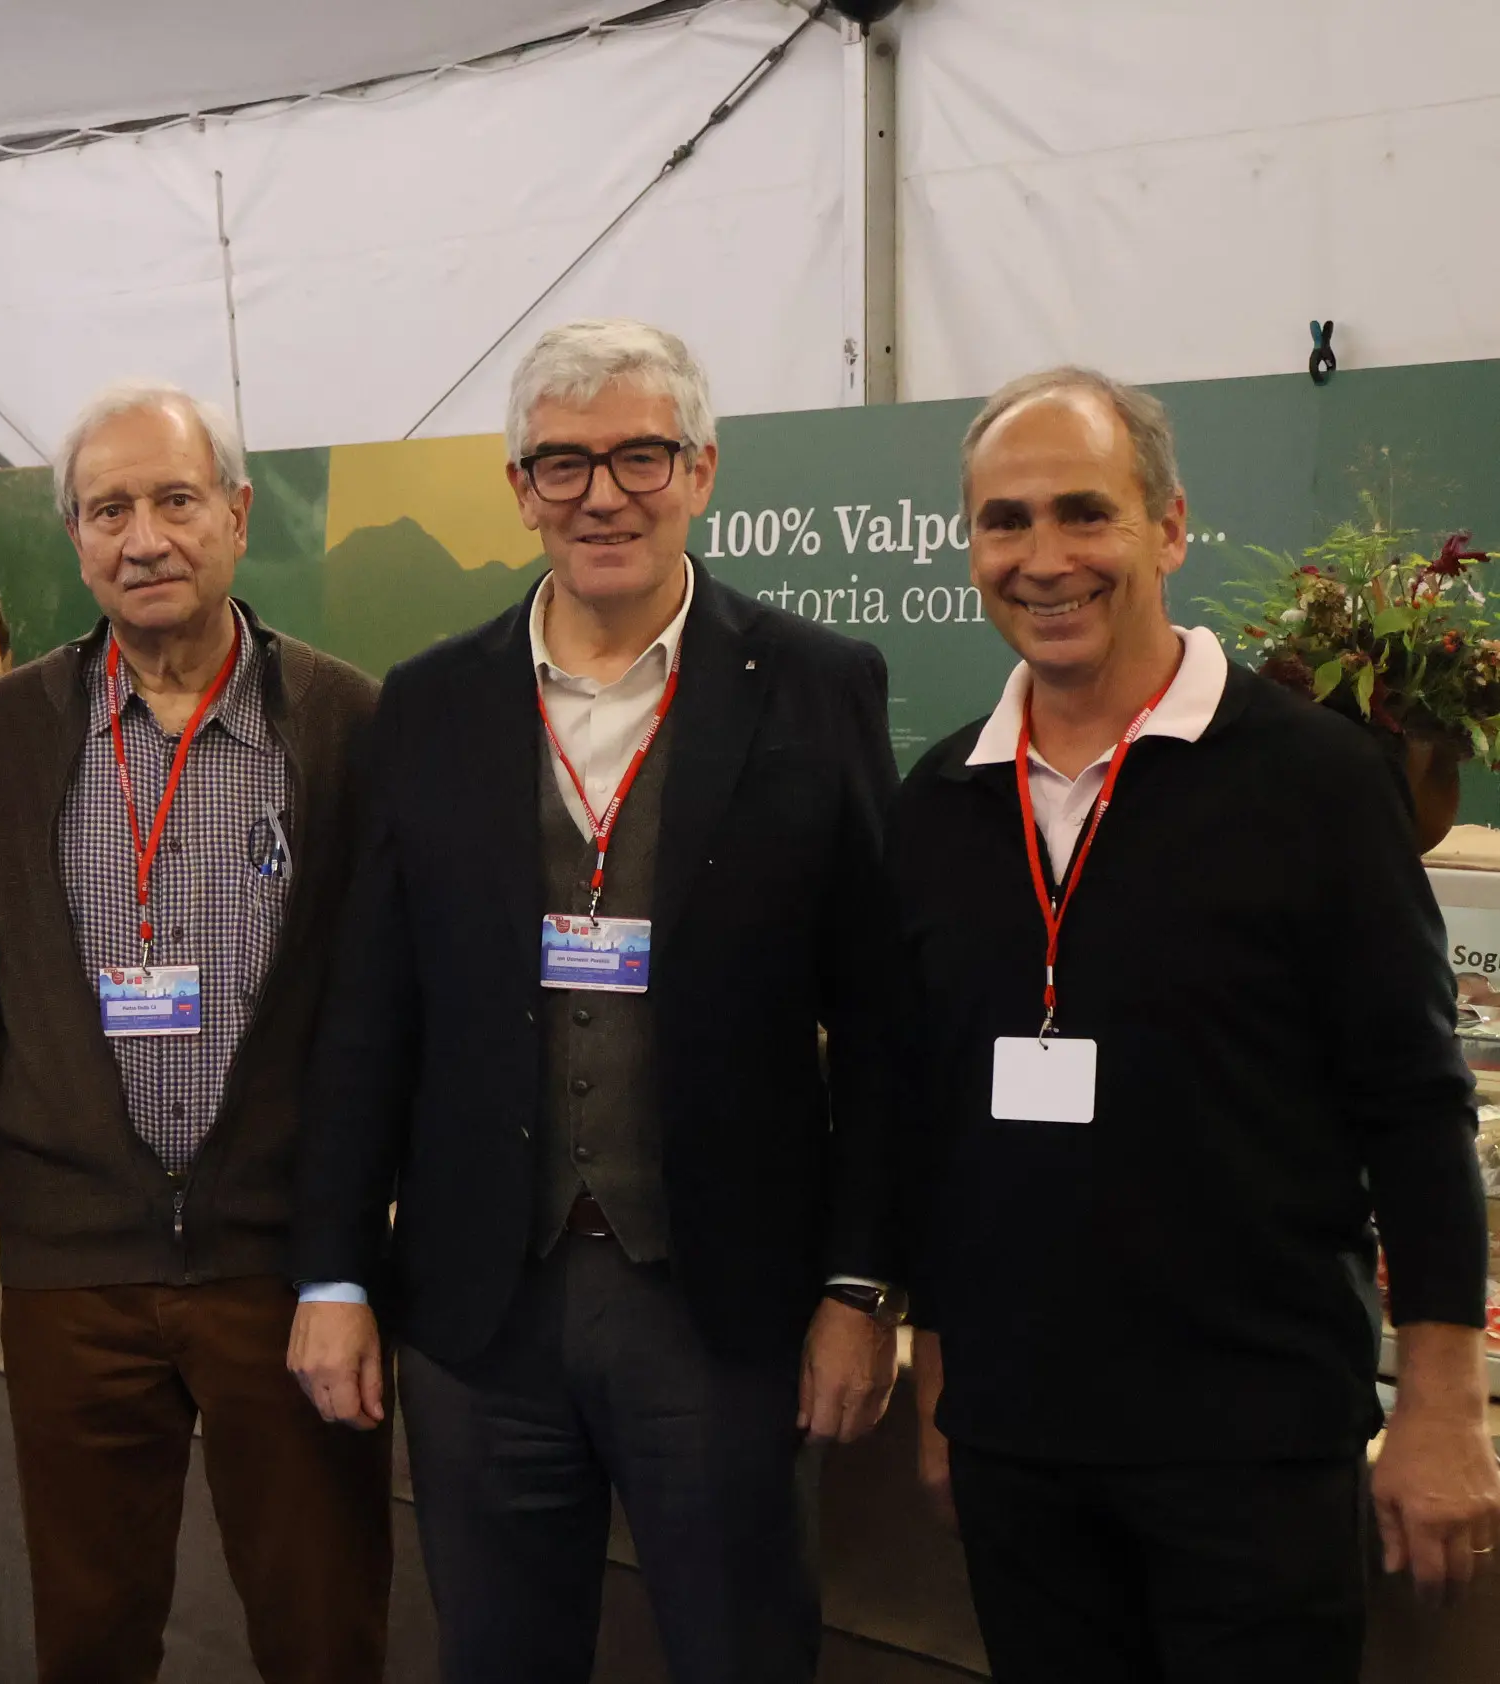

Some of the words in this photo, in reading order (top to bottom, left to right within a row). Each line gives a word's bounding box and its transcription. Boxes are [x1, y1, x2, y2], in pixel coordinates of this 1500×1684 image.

[704, 507, 821, 558] 100%
[833, 498, 971, 565] Valpo
[901, 586, 986, 624] con
[638, 714, 661, 753] RAIFFEISEN
[1123, 707, 1152, 744] RAIFFEISEN
[599, 796, 621, 838] RAIFFEISEN
[1452, 944, 1500, 974] Sog
